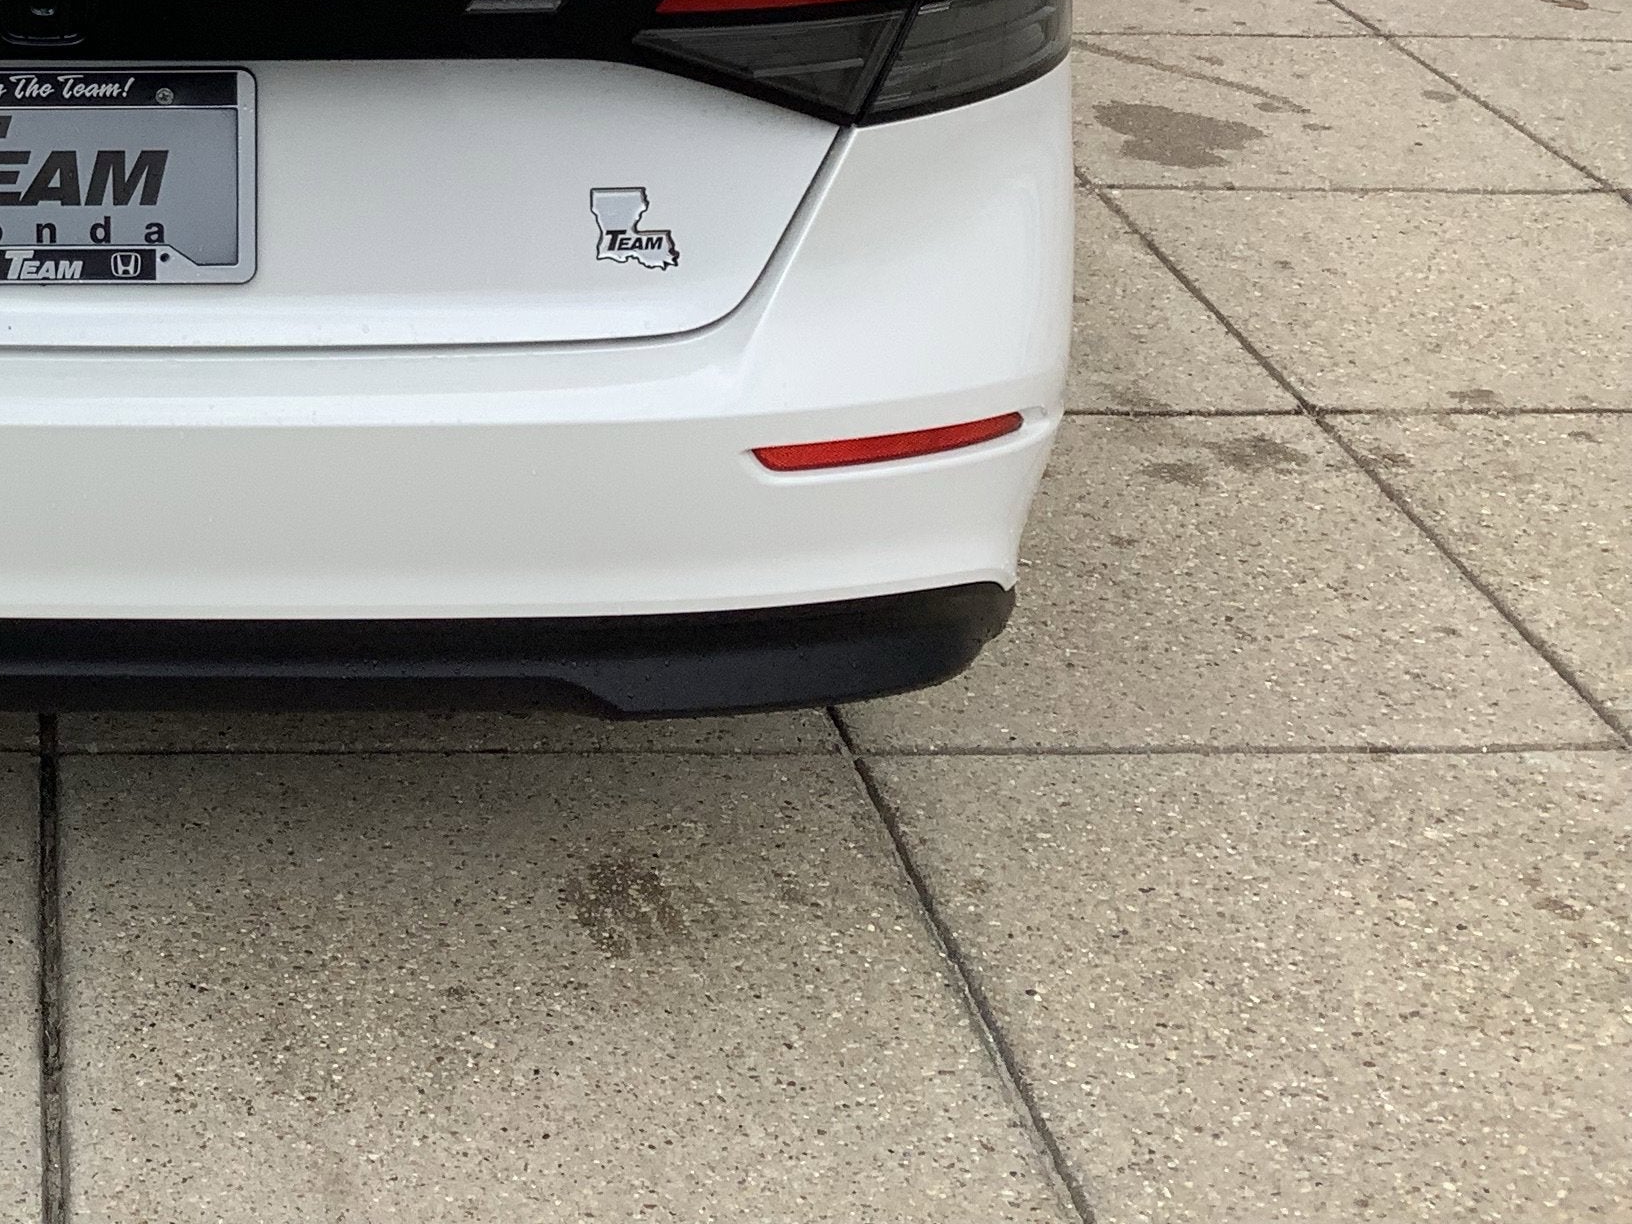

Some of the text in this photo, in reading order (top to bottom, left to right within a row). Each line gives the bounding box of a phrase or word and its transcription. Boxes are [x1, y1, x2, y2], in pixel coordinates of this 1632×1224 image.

[9, 75, 54, 99] The
[57, 75, 135, 99] Team!
[605, 229, 664, 252] TEAM
[4, 250, 84, 280] TEAM
